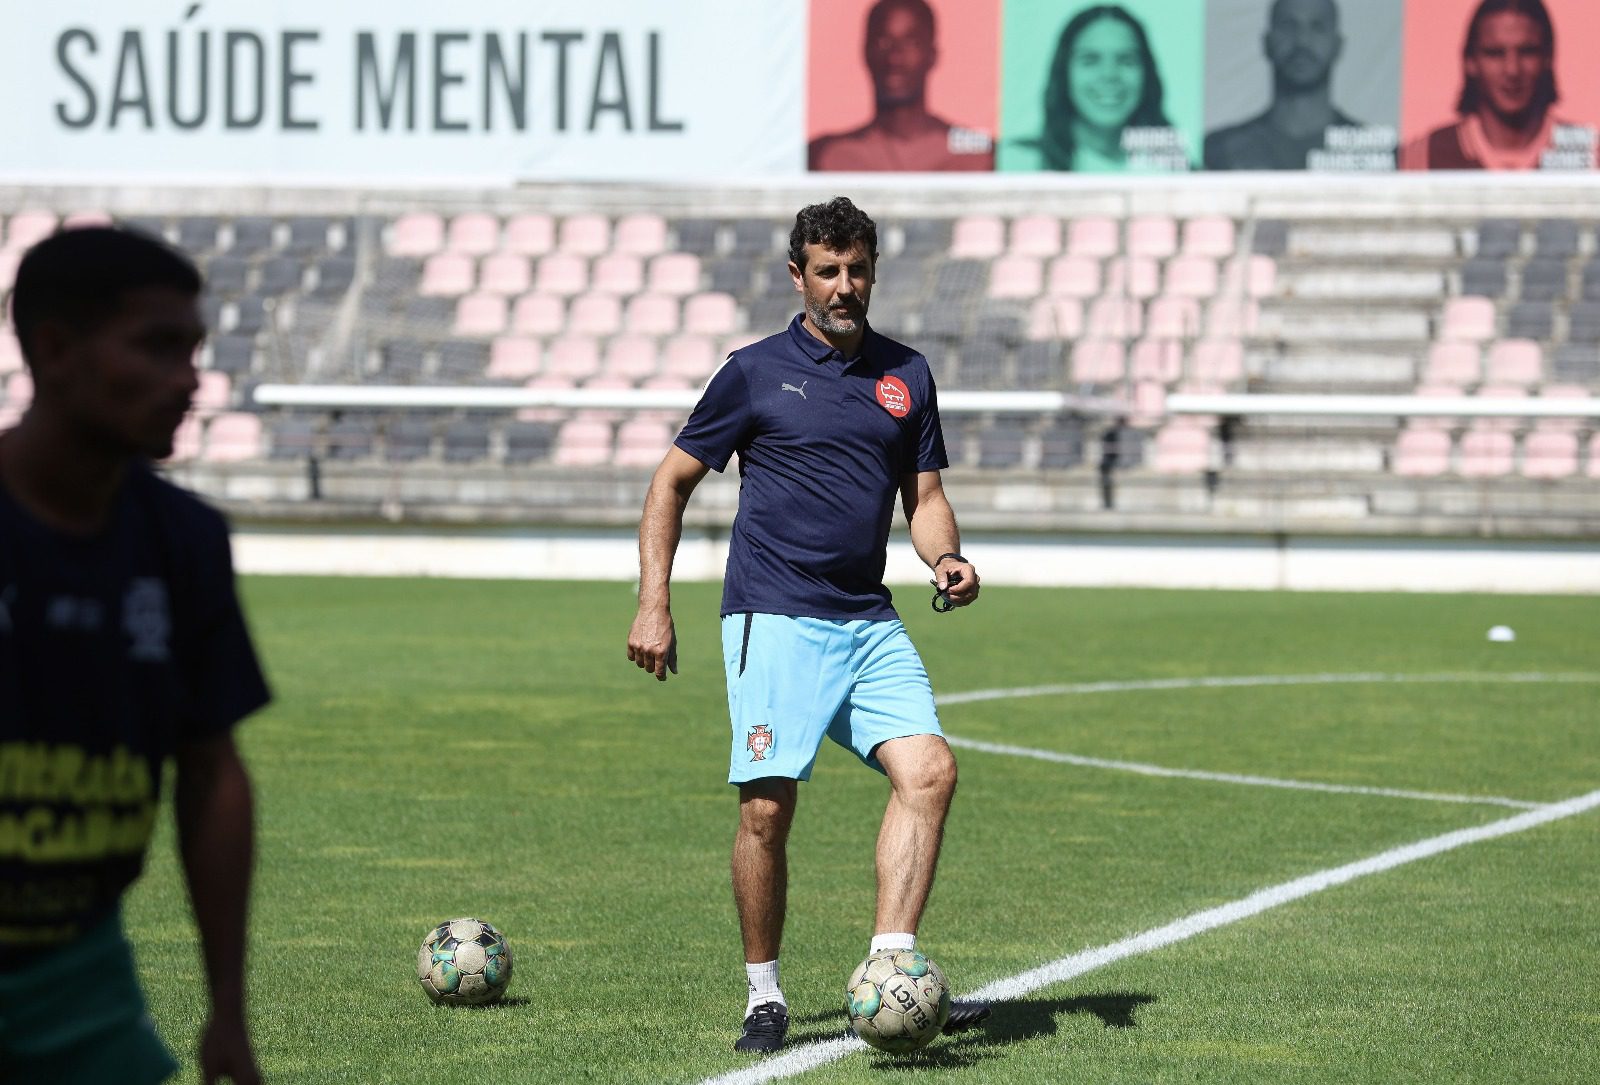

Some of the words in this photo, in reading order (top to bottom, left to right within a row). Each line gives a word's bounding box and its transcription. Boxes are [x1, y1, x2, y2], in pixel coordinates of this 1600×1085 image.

[55, 4, 320, 130] SAÚDE
[355, 31, 683, 131] MENTAL
[889, 984, 931, 1031] SELECT
